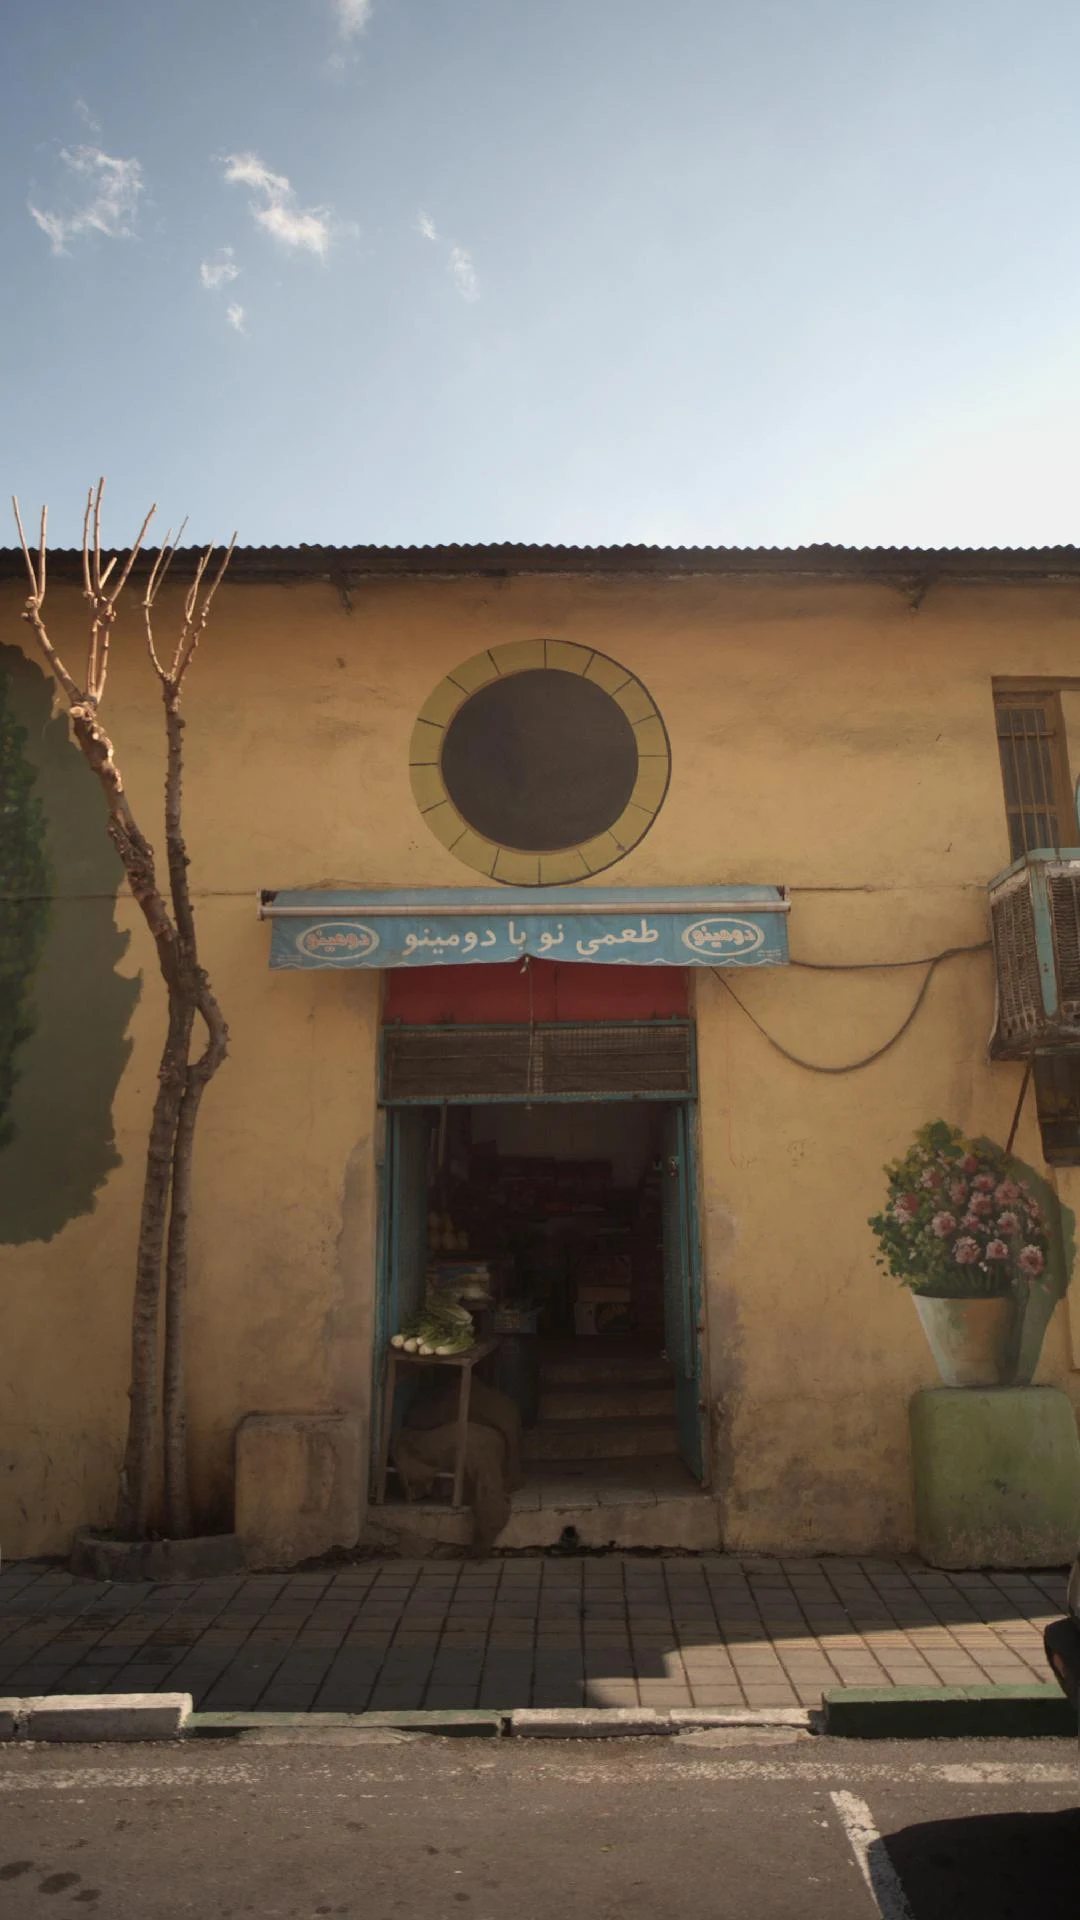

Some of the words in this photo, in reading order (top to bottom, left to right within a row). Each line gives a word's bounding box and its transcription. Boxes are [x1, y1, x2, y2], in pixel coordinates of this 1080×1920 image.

[306, 930, 370, 952] دومینو
[402, 928, 497, 956] دومینو
[509, 920, 526, 950] با
[537, 924, 565, 952] نو
[576, 919, 659, 955] طعمی
[692, 926, 756, 947] دومینو
